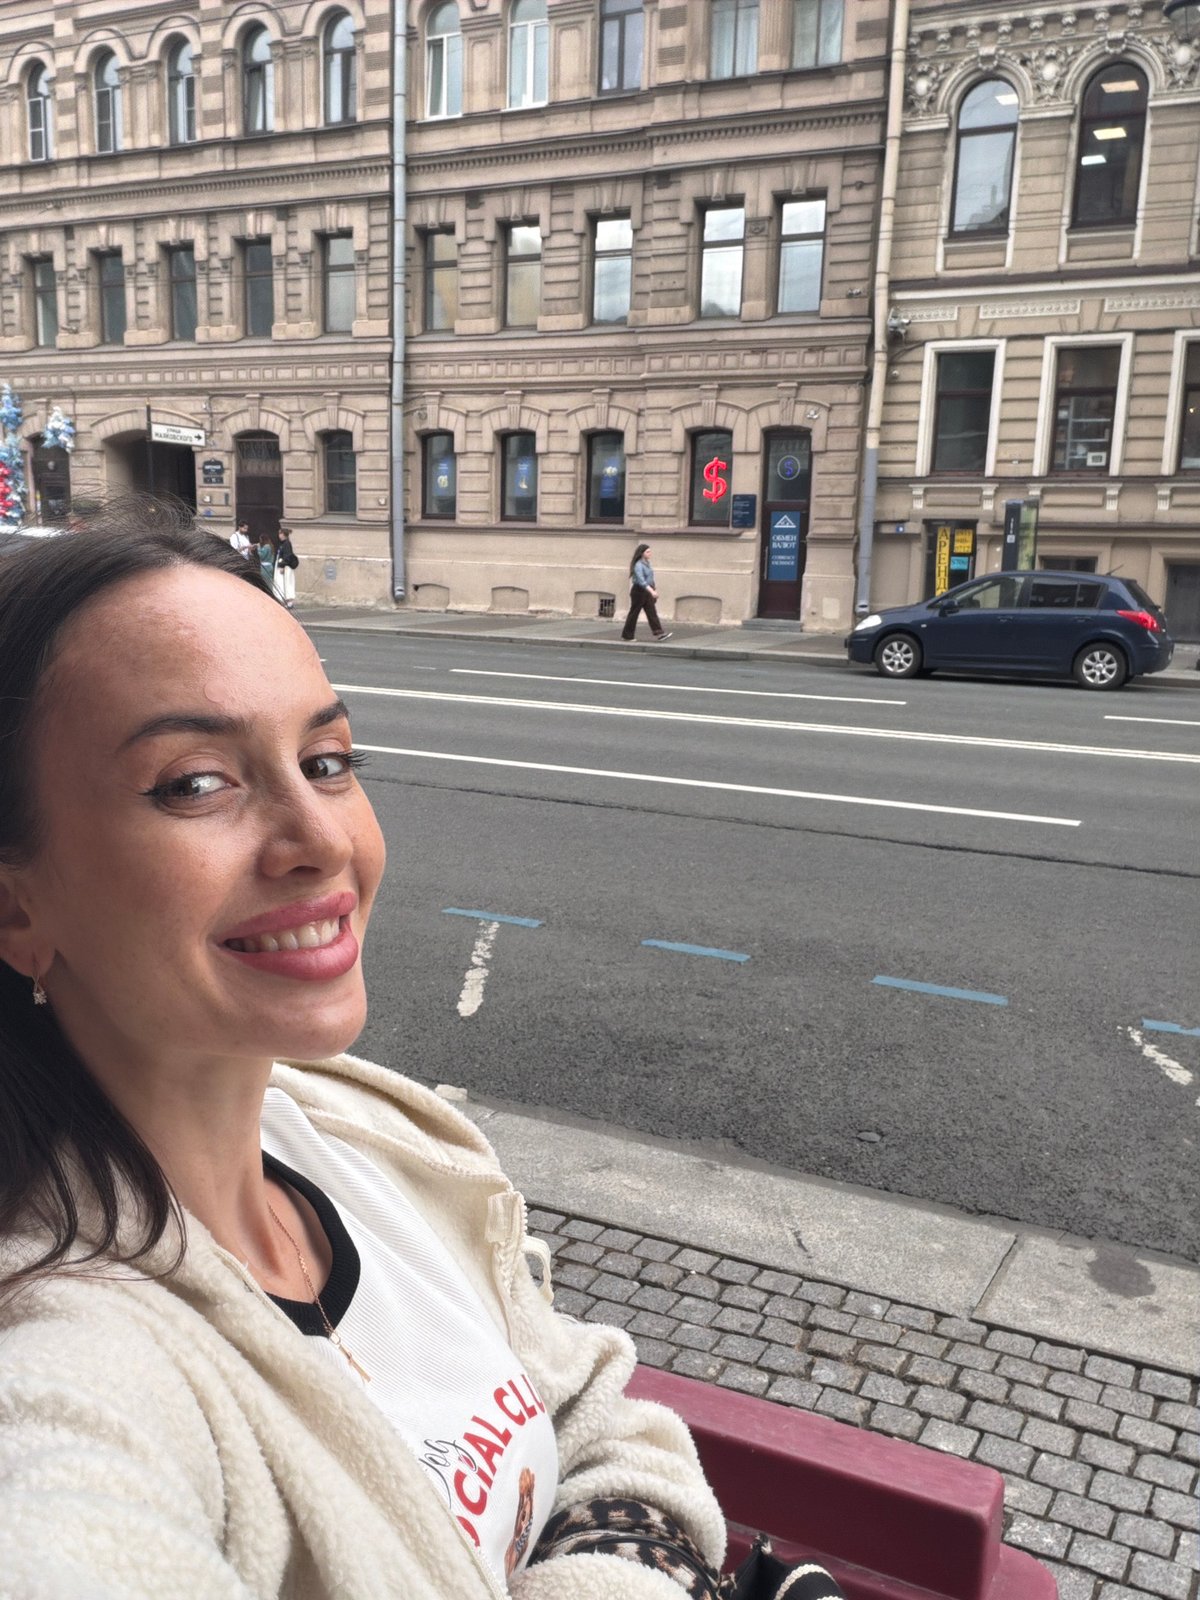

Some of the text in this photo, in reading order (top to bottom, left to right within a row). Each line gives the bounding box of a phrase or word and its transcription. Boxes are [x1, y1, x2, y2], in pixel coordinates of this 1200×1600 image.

[155, 432, 193, 442] МАЯКОВСКОГО
[703, 456, 727, 503] $
[937, 528, 949, 593] АРЕНД
